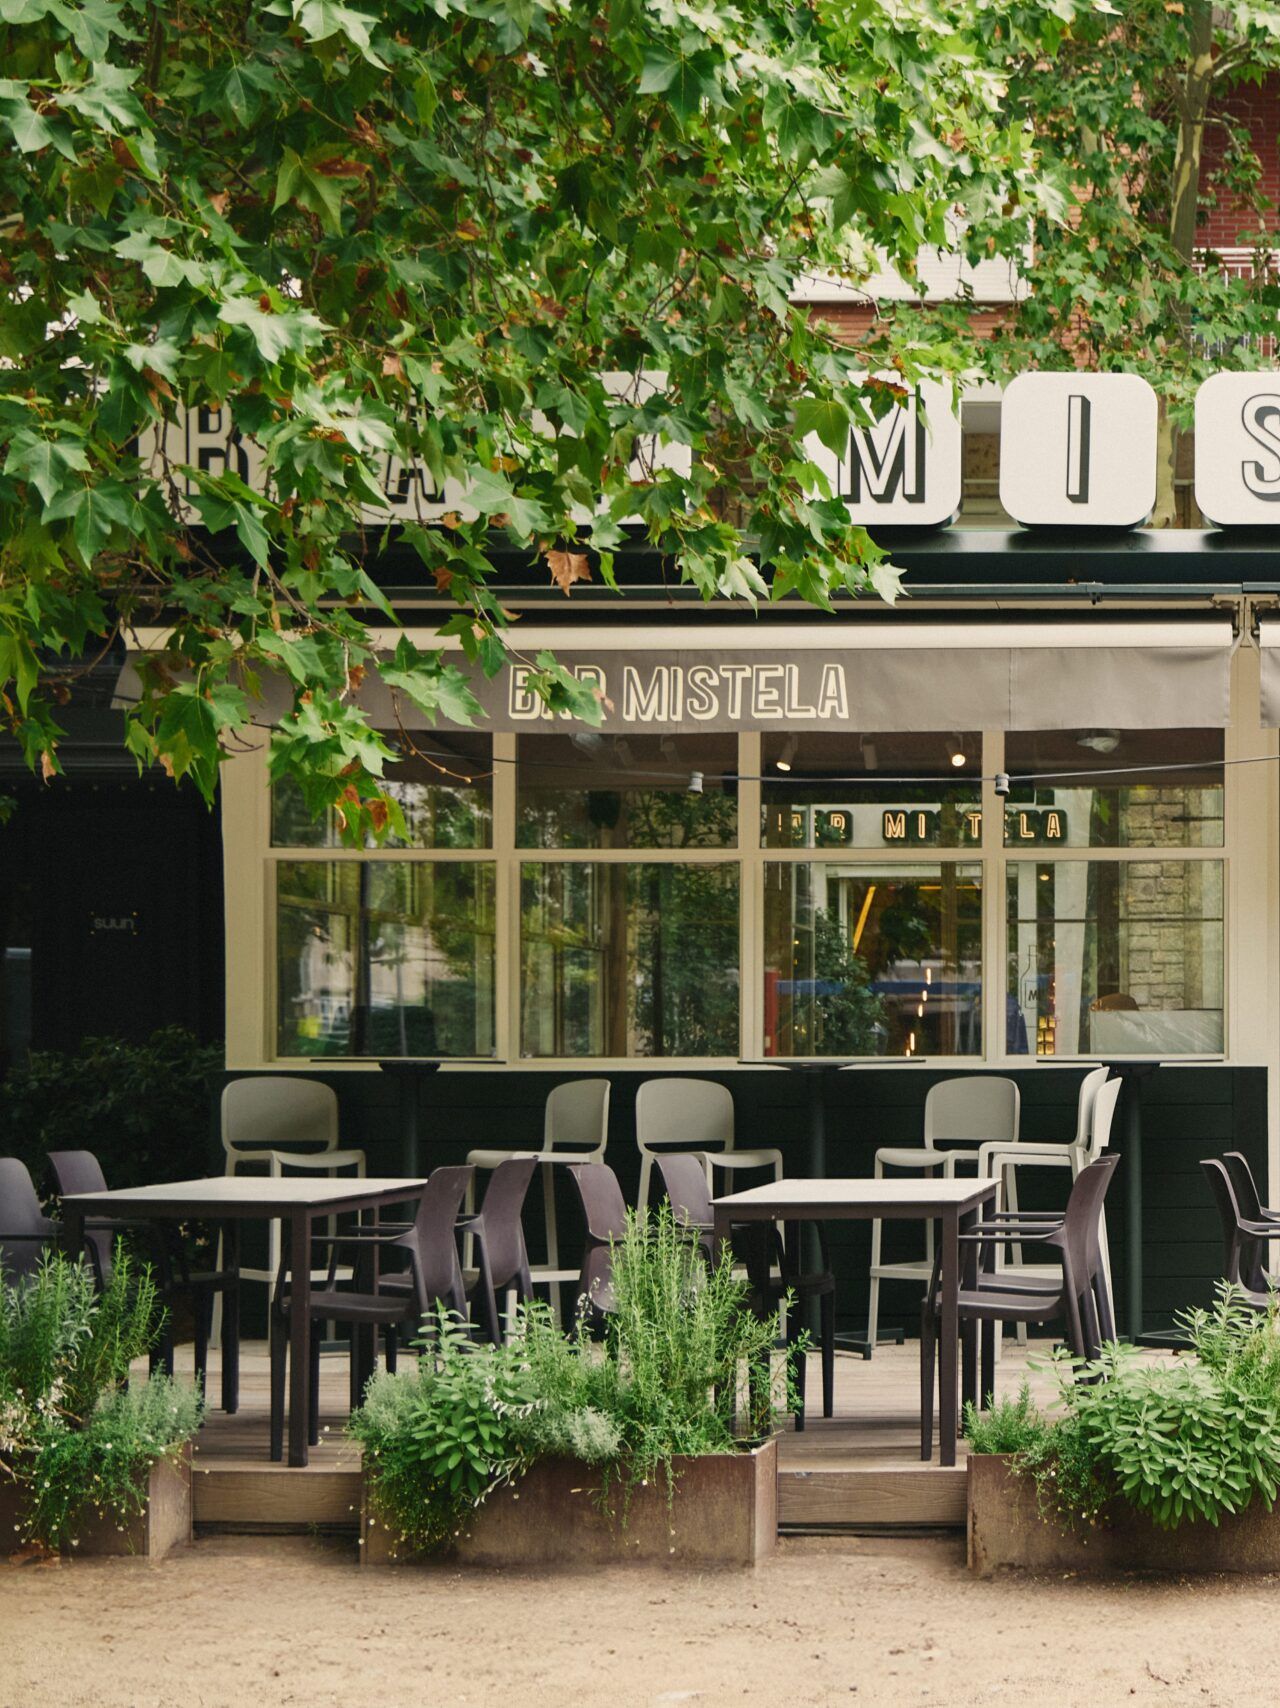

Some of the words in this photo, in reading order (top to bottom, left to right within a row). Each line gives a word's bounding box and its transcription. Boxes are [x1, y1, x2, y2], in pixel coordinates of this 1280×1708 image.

[186, 390, 644, 504] BA
[623, 664, 849, 721] MISTELA
[884, 813, 1061, 838] MITLA
